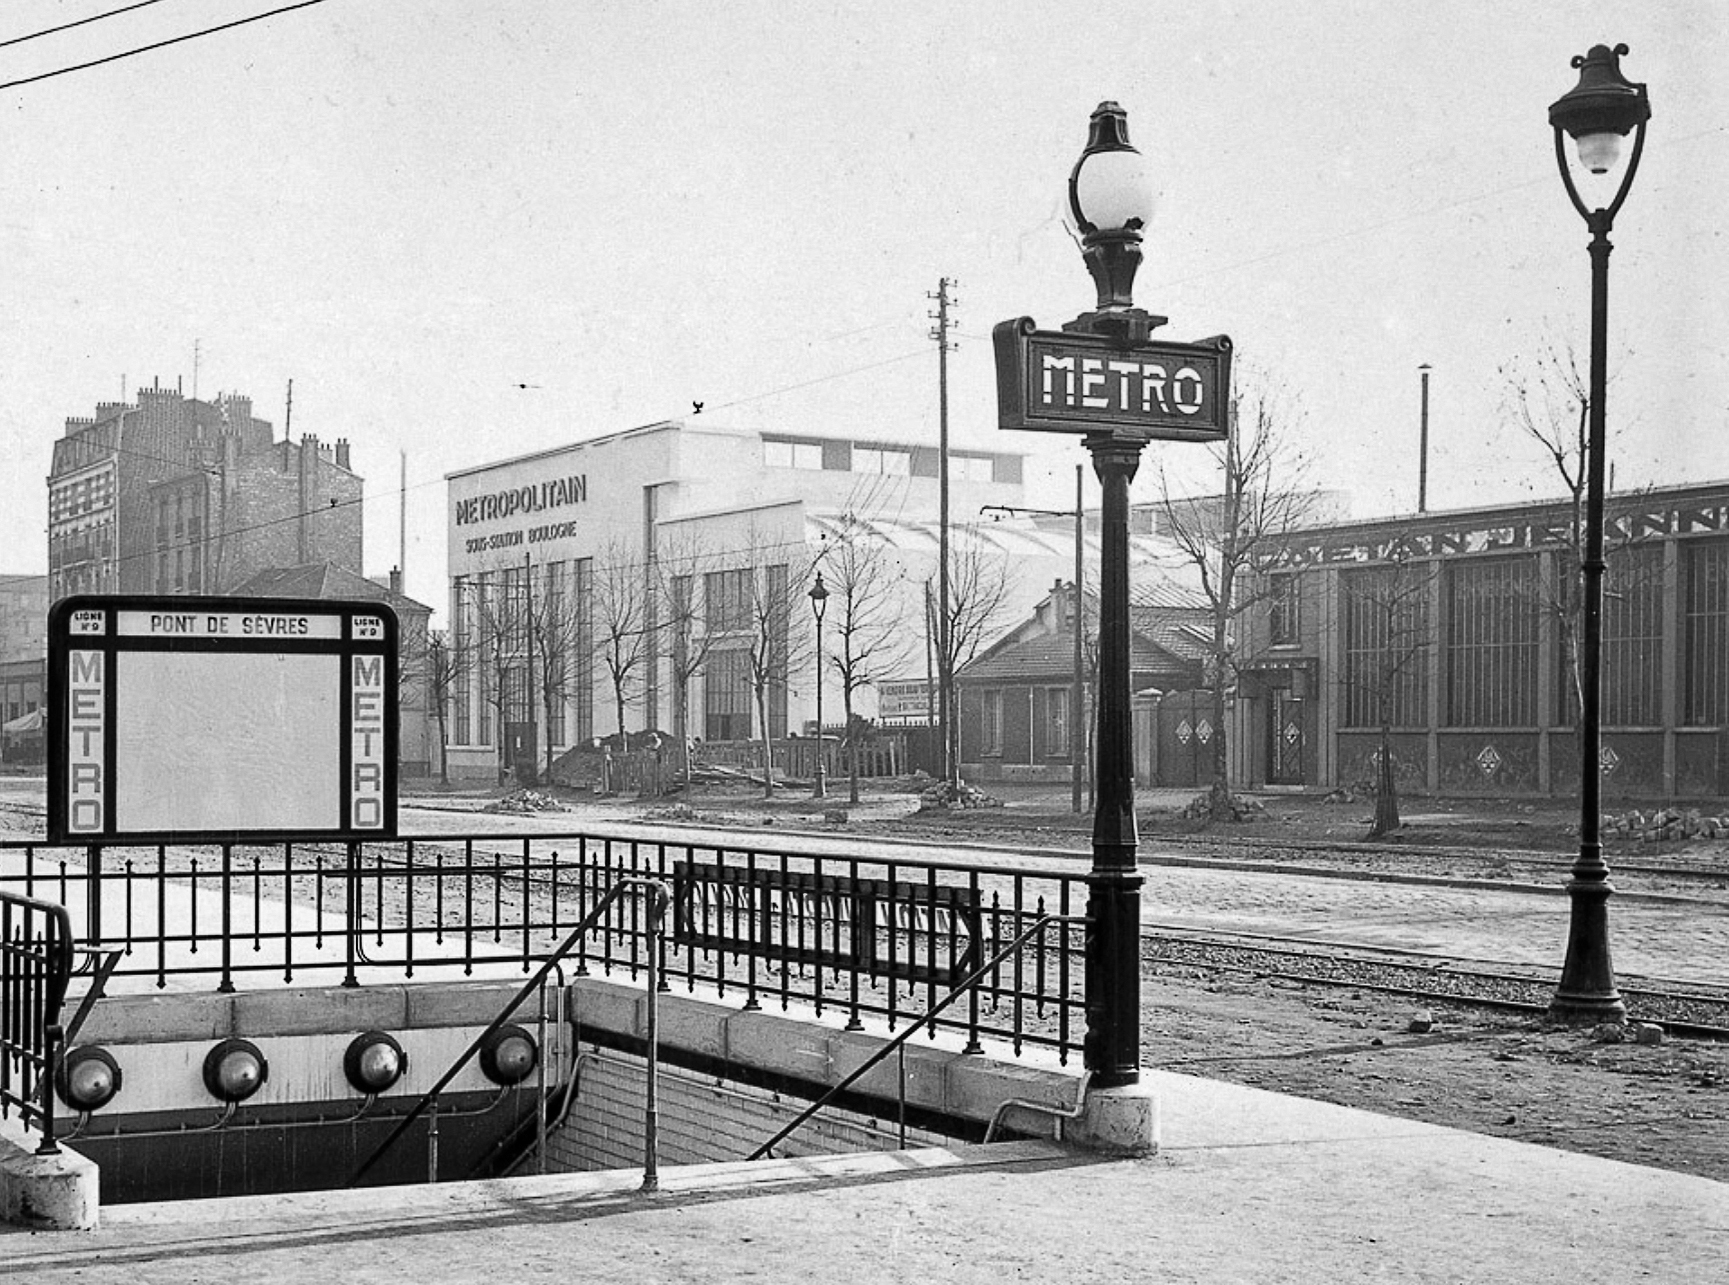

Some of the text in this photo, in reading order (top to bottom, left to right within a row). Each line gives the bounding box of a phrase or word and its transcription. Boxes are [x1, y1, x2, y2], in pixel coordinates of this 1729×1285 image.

[1043, 354, 1203, 415] METRO
[456, 474, 586, 526] METROPOLITAIN
[528, 521, 577, 544] BOULOGNE
[74, 612, 103, 622] LIGNE
[151, 614, 197, 633] PONT
[207, 615, 229, 634] DE
[354, 617, 380, 627] LIGNE
[72, 651, 101, 831] METRO
[354, 656, 381, 827] METRO
